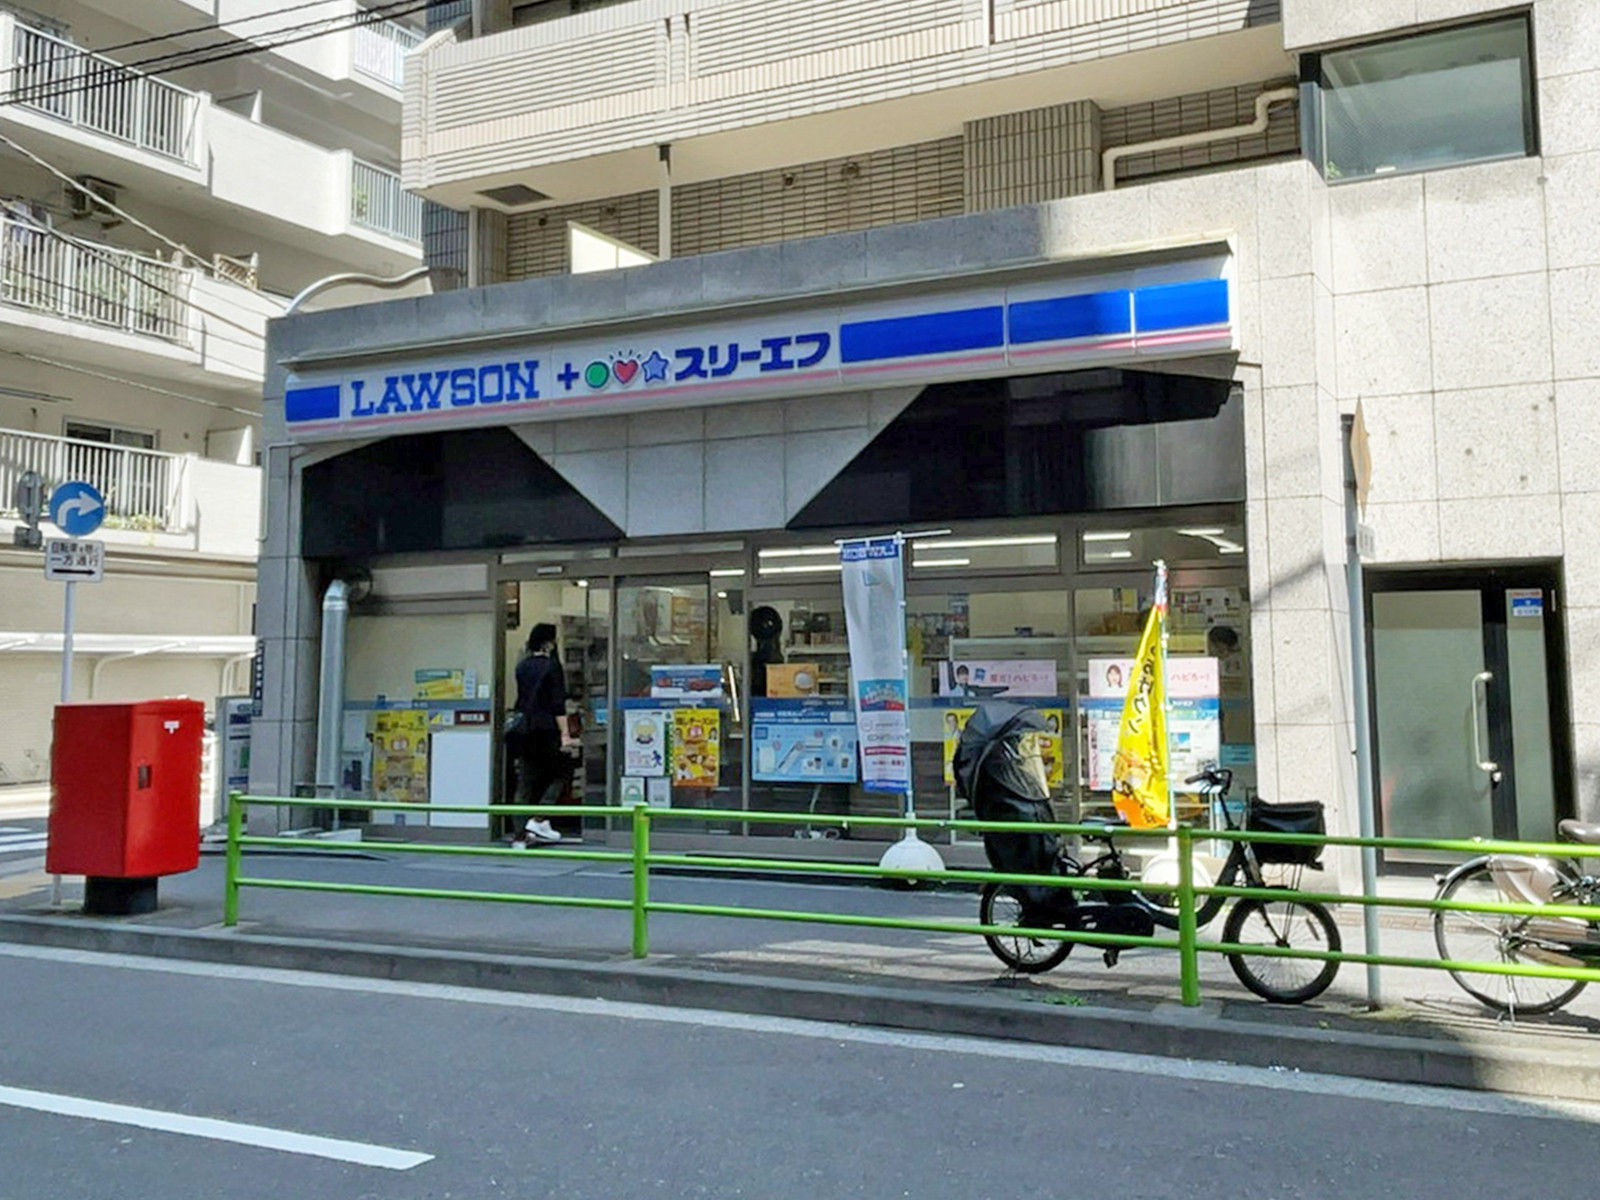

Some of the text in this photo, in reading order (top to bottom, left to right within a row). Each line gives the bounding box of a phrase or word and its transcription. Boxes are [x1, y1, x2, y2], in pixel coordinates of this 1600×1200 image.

[674, 332, 831, 382] スリーエフ
[351, 360, 539, 417] LAWSON
[51, 555, 98, 567] 一方通行
